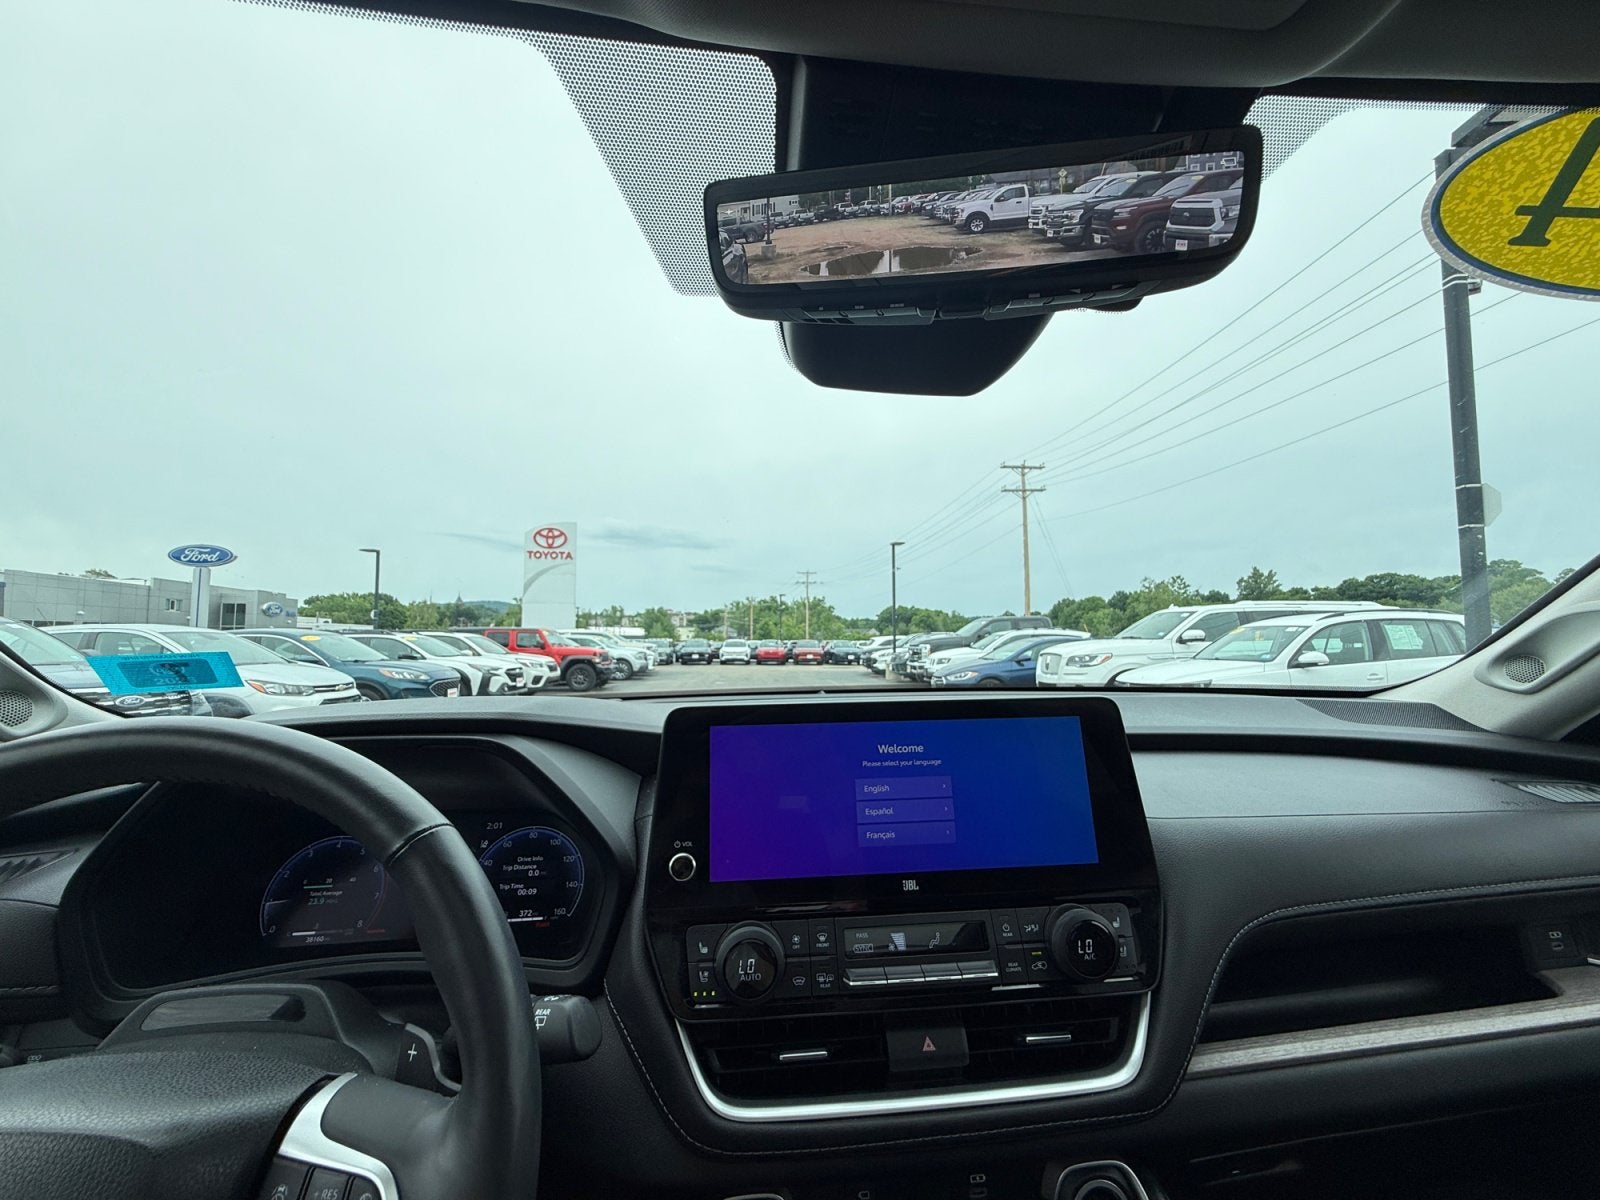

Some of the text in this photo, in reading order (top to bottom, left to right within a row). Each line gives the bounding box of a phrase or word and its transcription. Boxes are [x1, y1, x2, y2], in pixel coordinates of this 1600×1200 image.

[180, 548, 220, 562] Ford
[526, 550, 573, 560] TOYOTA
[877, 744, 924, 754] Welcome
[864, 785, 890, 794] English
[865, 807, 894, 816] Español
[866, 831, 895, 840] Français
[902, 880, 919, 891] JBL
[517, 888, 537, 896] 00:09
[855, 944, 873, 953] SYNC
[1078, 939, 1093, 954] LO
[738, 958, 755, 975] LO
[740, 972, 762, 982] AUTO
[535, 1008, 551, 1016] REAR
[321, 1188, 339, 1200] RES
